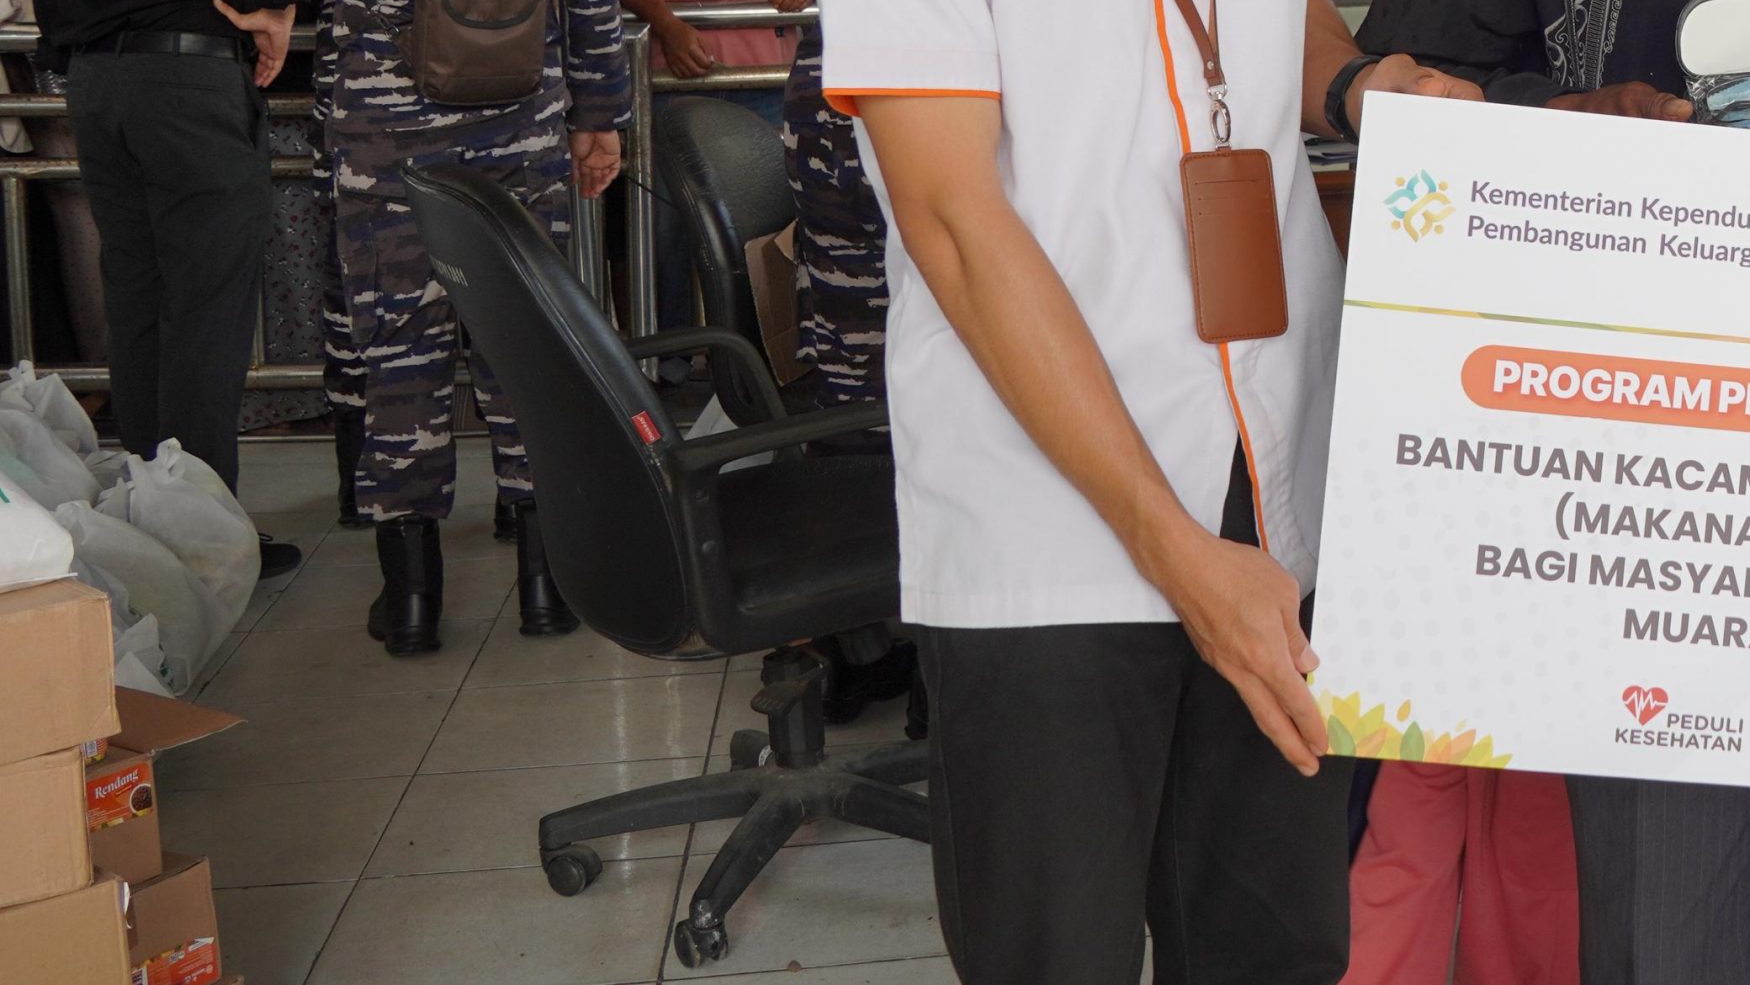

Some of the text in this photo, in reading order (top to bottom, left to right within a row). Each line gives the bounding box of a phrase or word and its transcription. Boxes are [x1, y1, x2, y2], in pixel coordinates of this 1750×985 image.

[1470, 180, 1632, 217] Kementerian
[1467, 215, 1647, 253] Pembangunan
[1493, 359, 1713, 412] PROGRAM
[1396, 433, 1605, 484] BANTUAN
[1475, 544, 1579, 584] BAGI
[1614, 728, 1743, 753] KESEHATAN
[1666, 713, 1744, 734] PEDULI
[95, 767, 139, 800] Rendang
